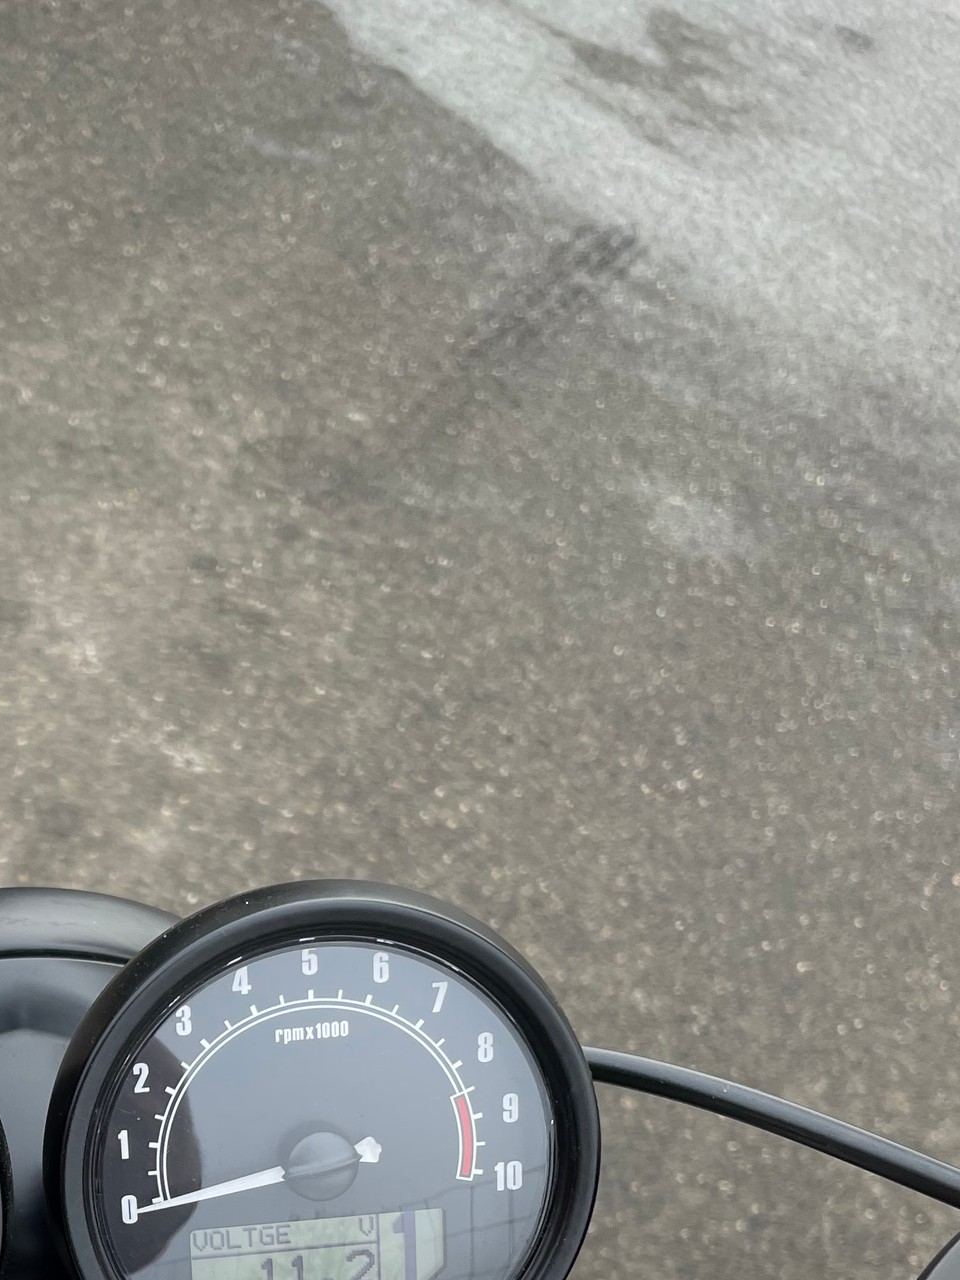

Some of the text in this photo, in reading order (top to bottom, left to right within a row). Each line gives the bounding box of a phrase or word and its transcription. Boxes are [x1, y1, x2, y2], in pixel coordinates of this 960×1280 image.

[301, 948, 318, 975] 5
[373, 951, 390, 984] 6
[232, 966, 252, 995] 4
[431, 982, 448, 1012] 7
[175, 1007, 192, 1035] 3
[477, 1032, 494, 1063] 8
[132, 1062, 151, 1093] 2
[502, 1093, 519, 1123] 9
[117, 1130, 130, 1159] 1
[494, 1161, 524, 1191] 10
[121, 1194, 139, 1224] 0
[193, 1216, 375, 1252] VOLTGE V
